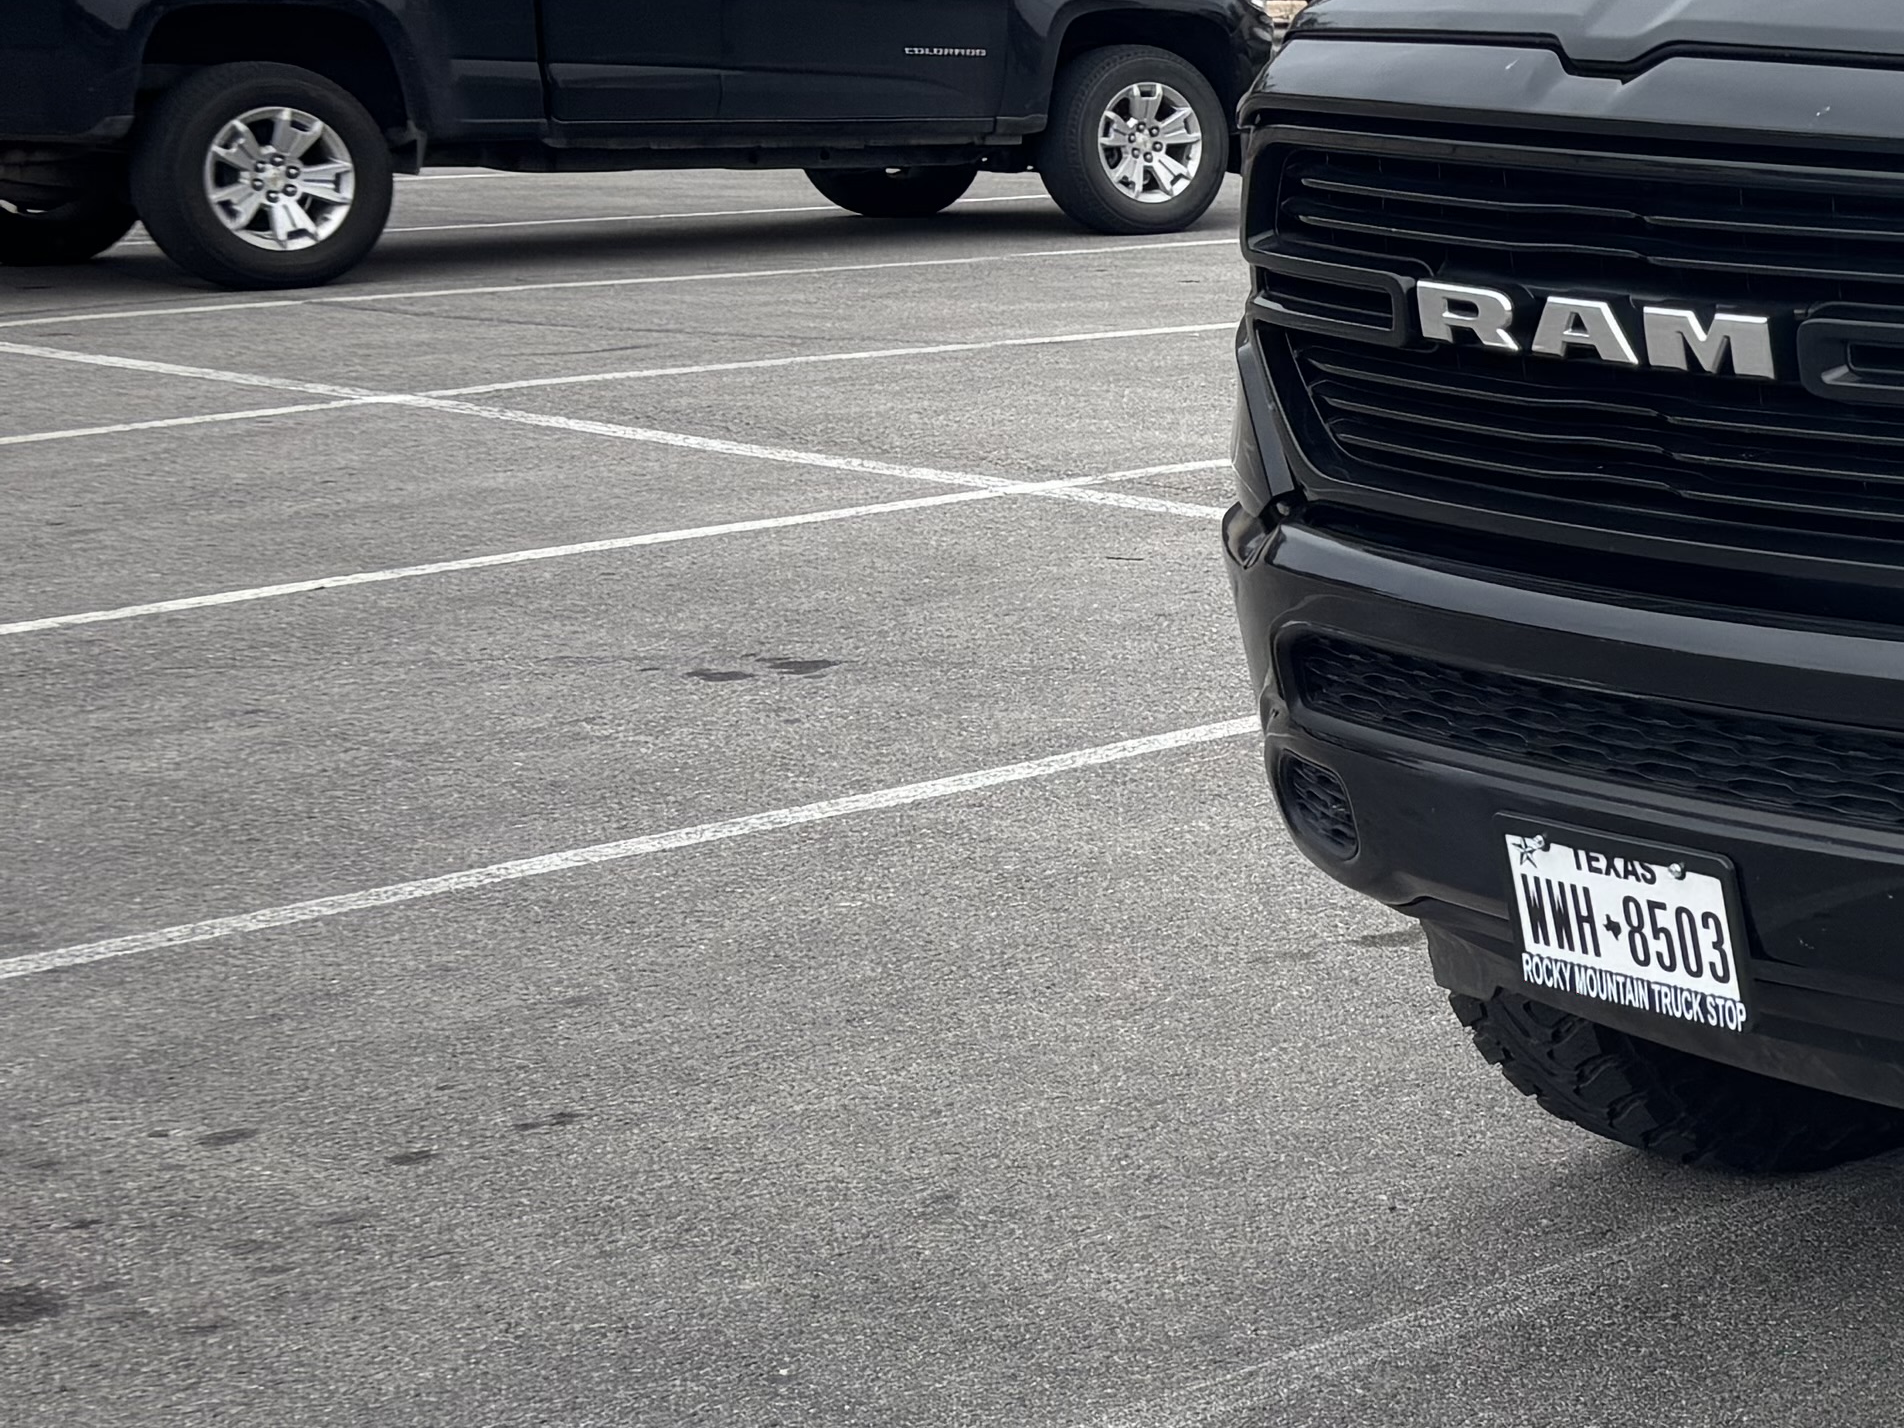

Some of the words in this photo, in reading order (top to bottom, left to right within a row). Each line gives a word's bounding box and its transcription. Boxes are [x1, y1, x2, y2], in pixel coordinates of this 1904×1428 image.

[904, 47, 987, 57] COLORADO
[1416, 280, 1776, 380] RAM
[1572, 849, 1658, 885] TEXAS
[1522, 953, 1572, 993] ROCKY
[1574, 965, 1650, 1011] MOUNTAIN
[1651, 983, 1704, 1023] TRUCK
[1706, 996, 1747, 1032] STOP
